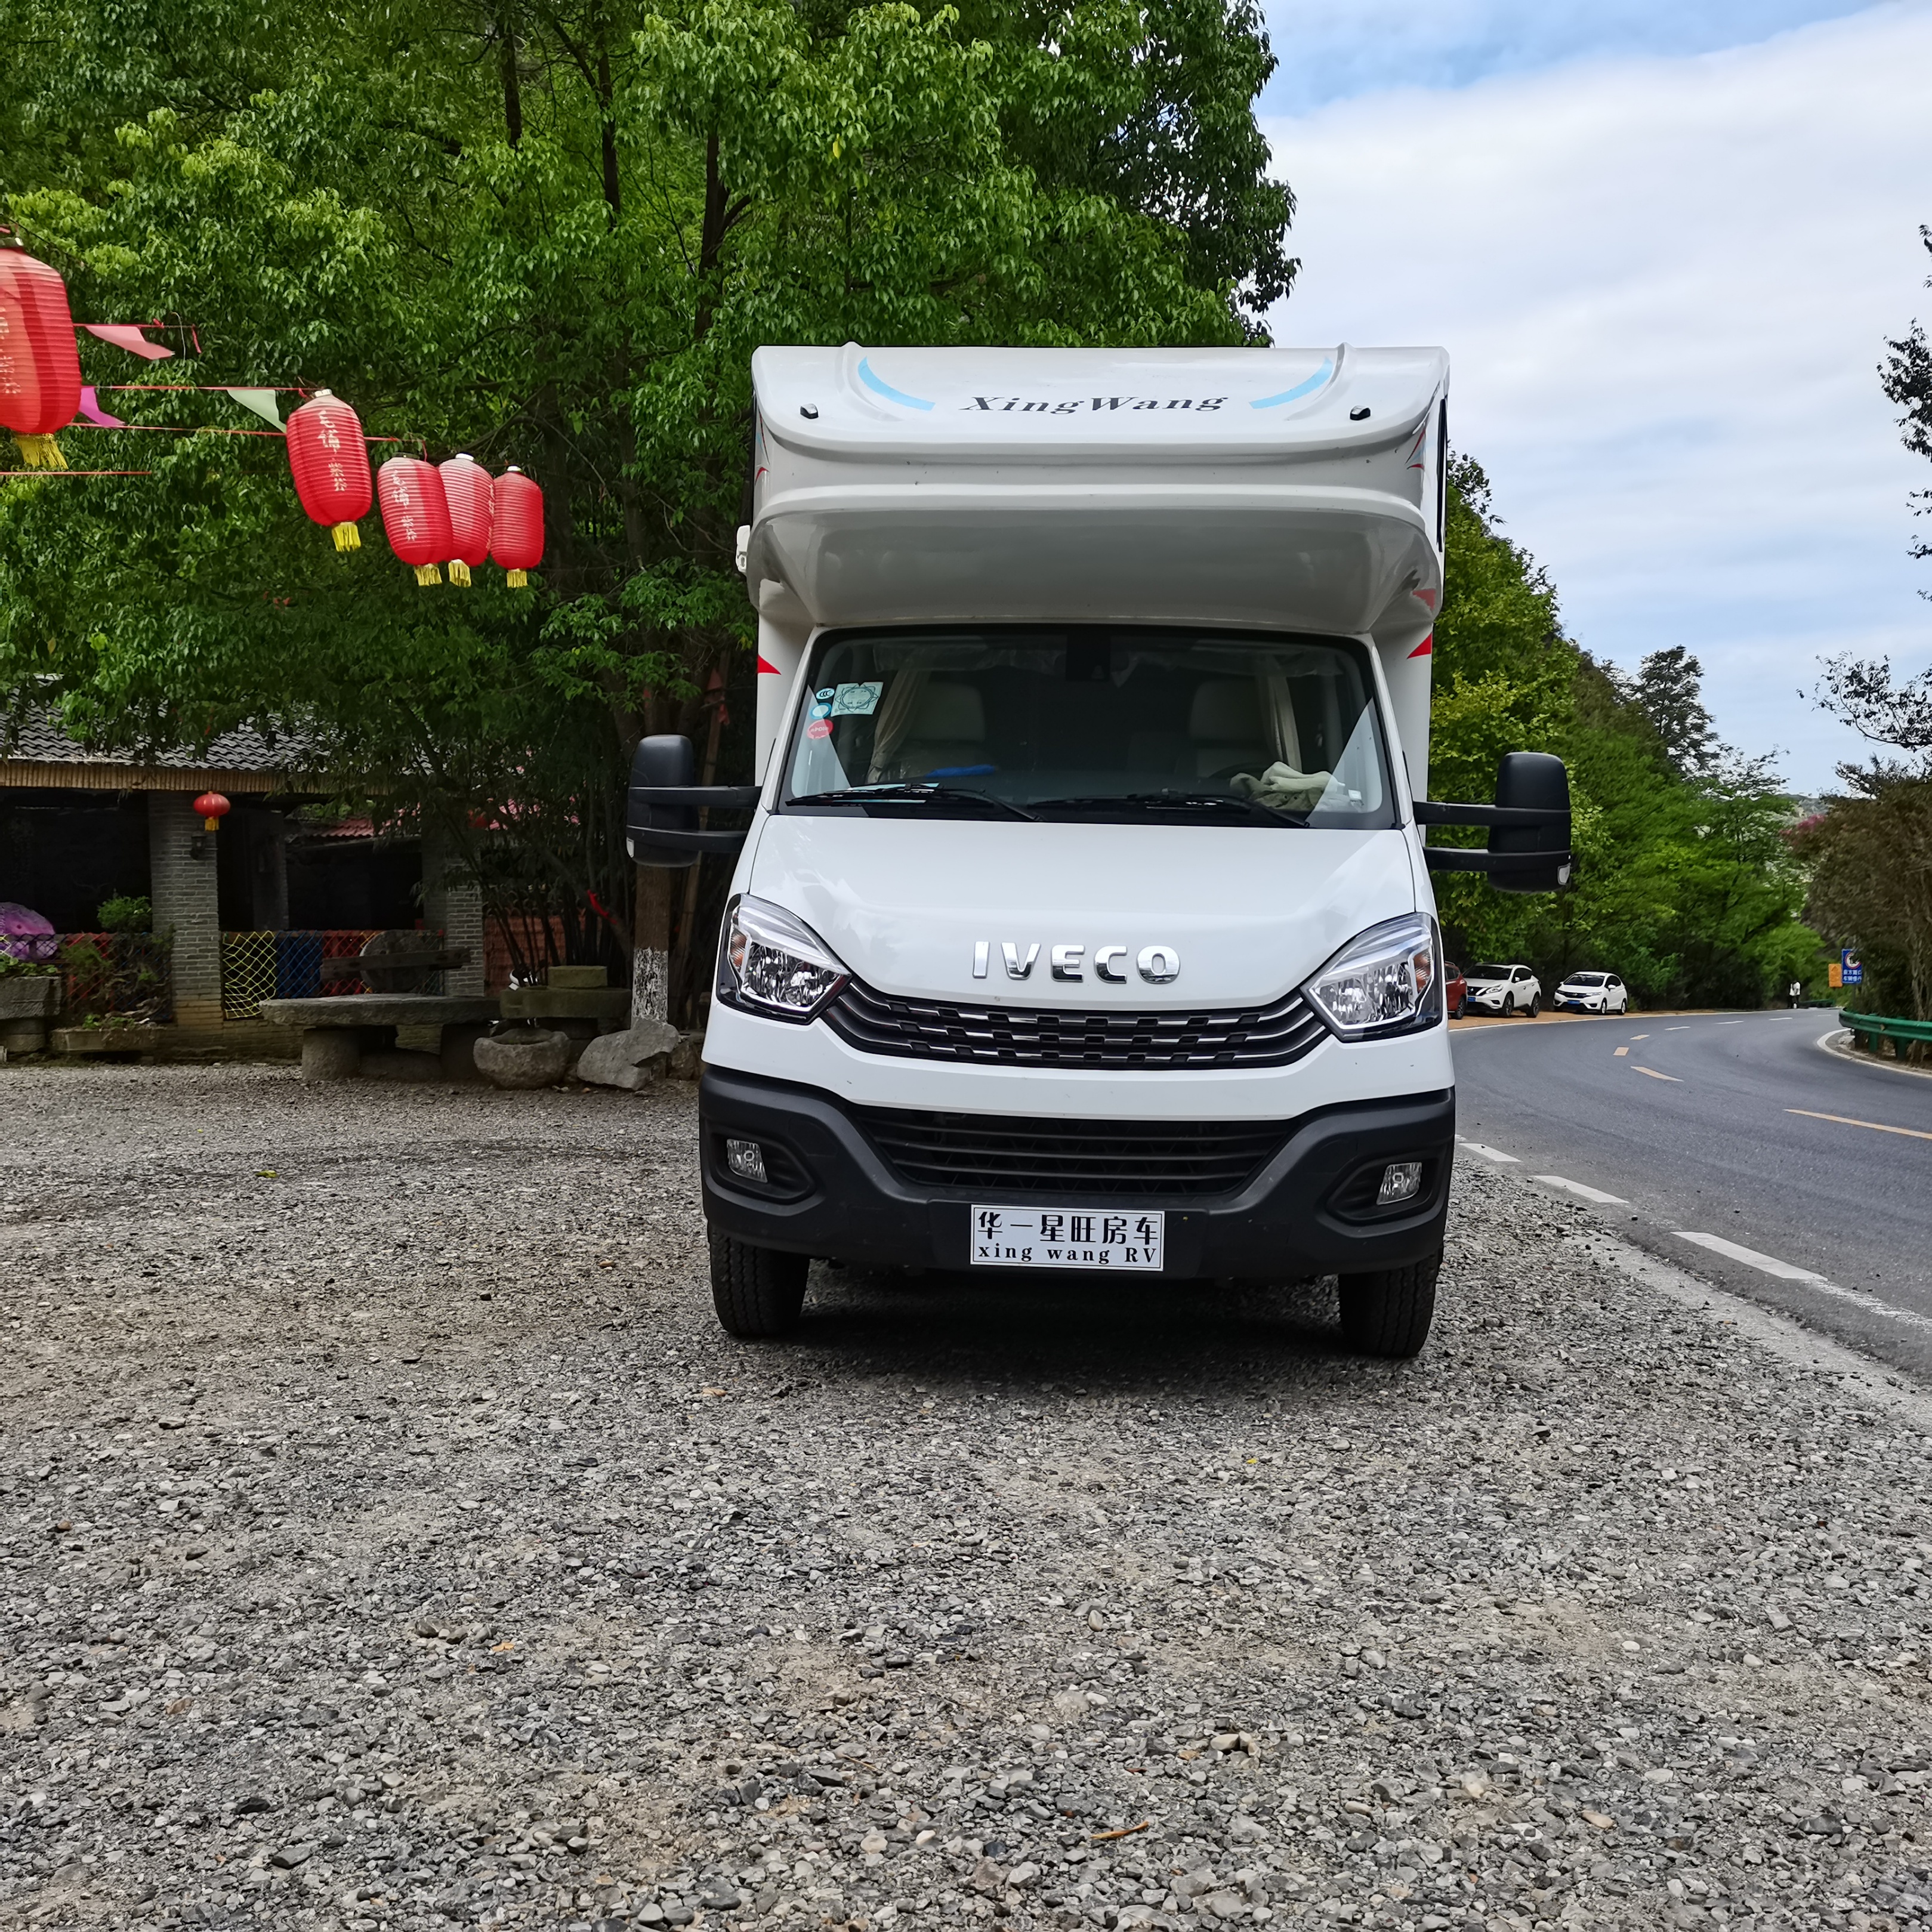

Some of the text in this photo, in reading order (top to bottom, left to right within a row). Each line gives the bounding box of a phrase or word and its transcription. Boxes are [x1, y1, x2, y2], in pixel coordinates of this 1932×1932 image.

[958, 396, 1229, 415] XingWang
[972, 941, 1180, 984] IVECO
[977, 1211, 1158, 1245] 华一星旺房车
[978, 1243, 1157, 1265] xing wang RV
